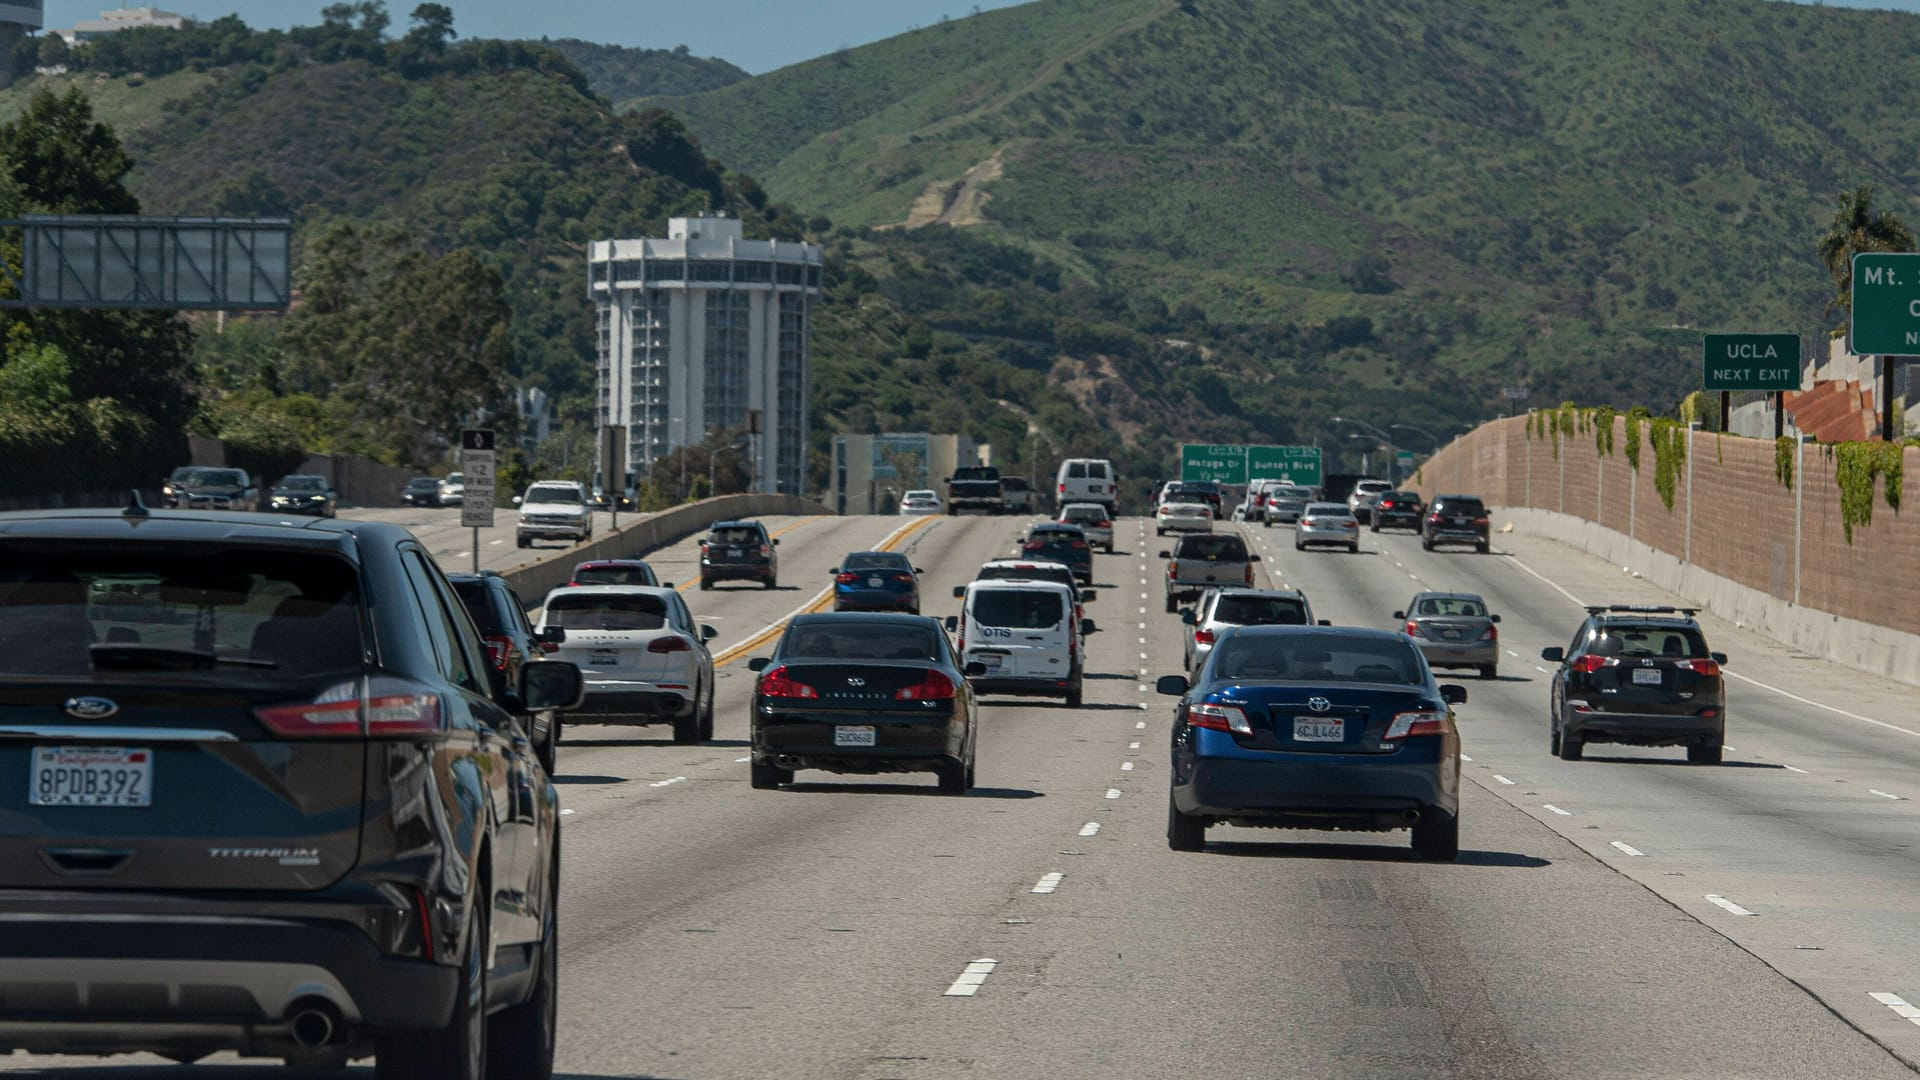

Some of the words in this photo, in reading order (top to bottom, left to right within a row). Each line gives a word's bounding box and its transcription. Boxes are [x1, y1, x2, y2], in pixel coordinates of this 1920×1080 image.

[1864, 267, 1903, 285] Mt.
[1905, 331, 1920, 345] N
[1727, 344, 1778, 358] UCLA
[1713, 369, 1751, 380] NEXT
[1759, 369, 1790, 380] EXIT
[1254, 461, 1289, 469] Sunset
[1292, 461, 1315, 470] Blvd
[983, 628, 1011, 638] OTIS
[39, 769, 142, 795] 8PDB392
[207, 847, 319, 857] TITANIUM
